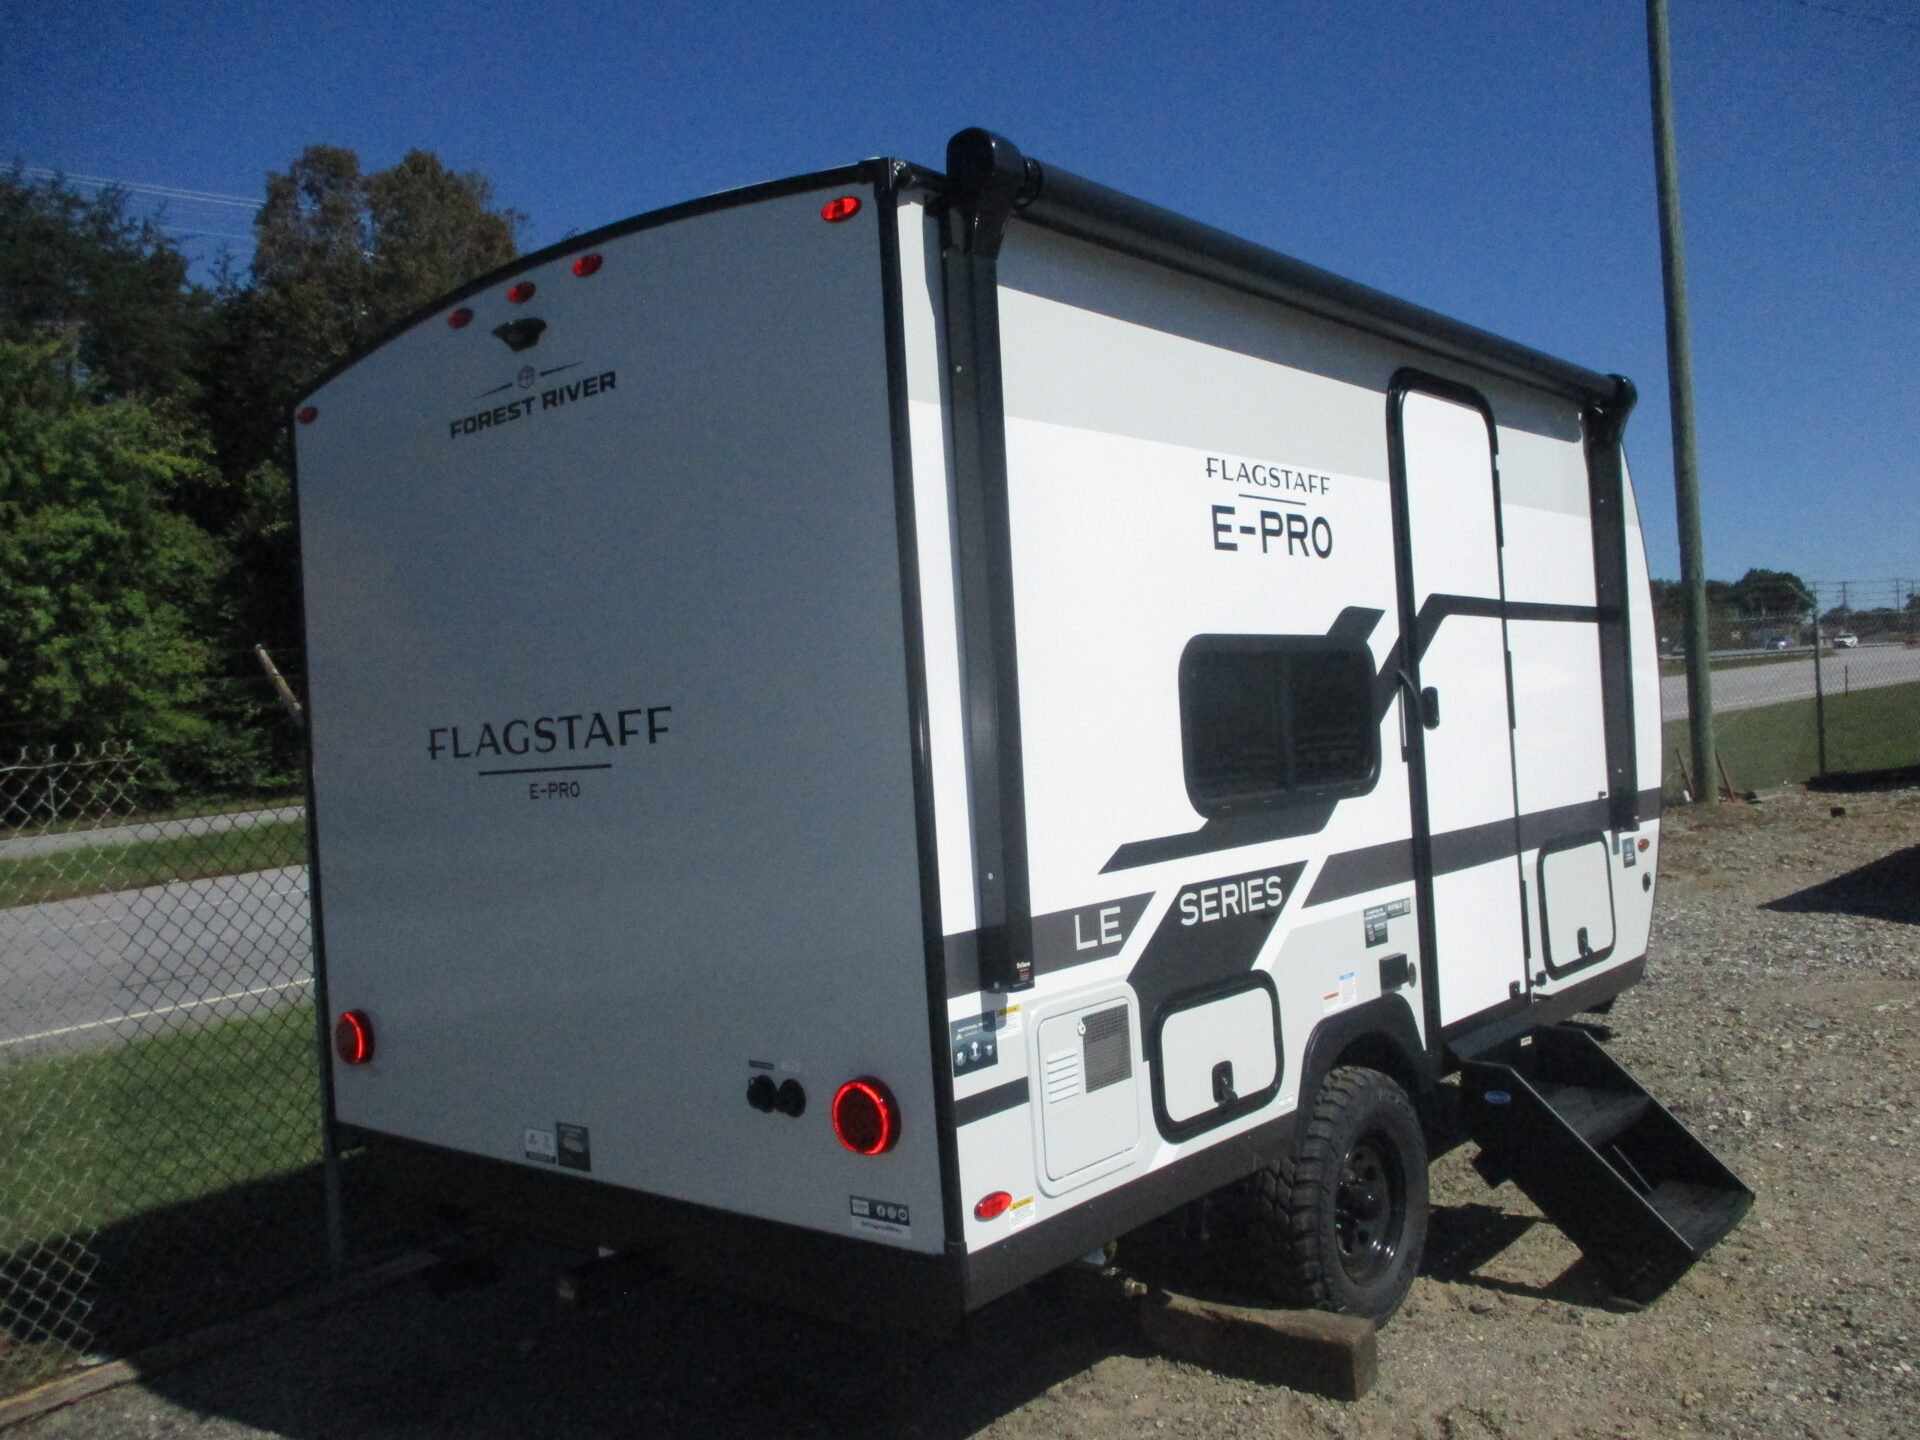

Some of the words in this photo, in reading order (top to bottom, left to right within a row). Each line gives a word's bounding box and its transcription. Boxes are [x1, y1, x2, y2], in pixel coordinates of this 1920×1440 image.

[449, 397, 536, 440] FOREST
[541, 370, 617, 411] RIVER
[1205, 456, 1331, 495] FLAGSTAFF
[1211, 504, 1334, 560] E-PRO
[427, 705, 672, 761] FLAGSTAFF
[529, 780, 581, 800] E-PRO
[1074, 906, 1123, 951] LE
[1179, 875, 1284, 927] SERIES
